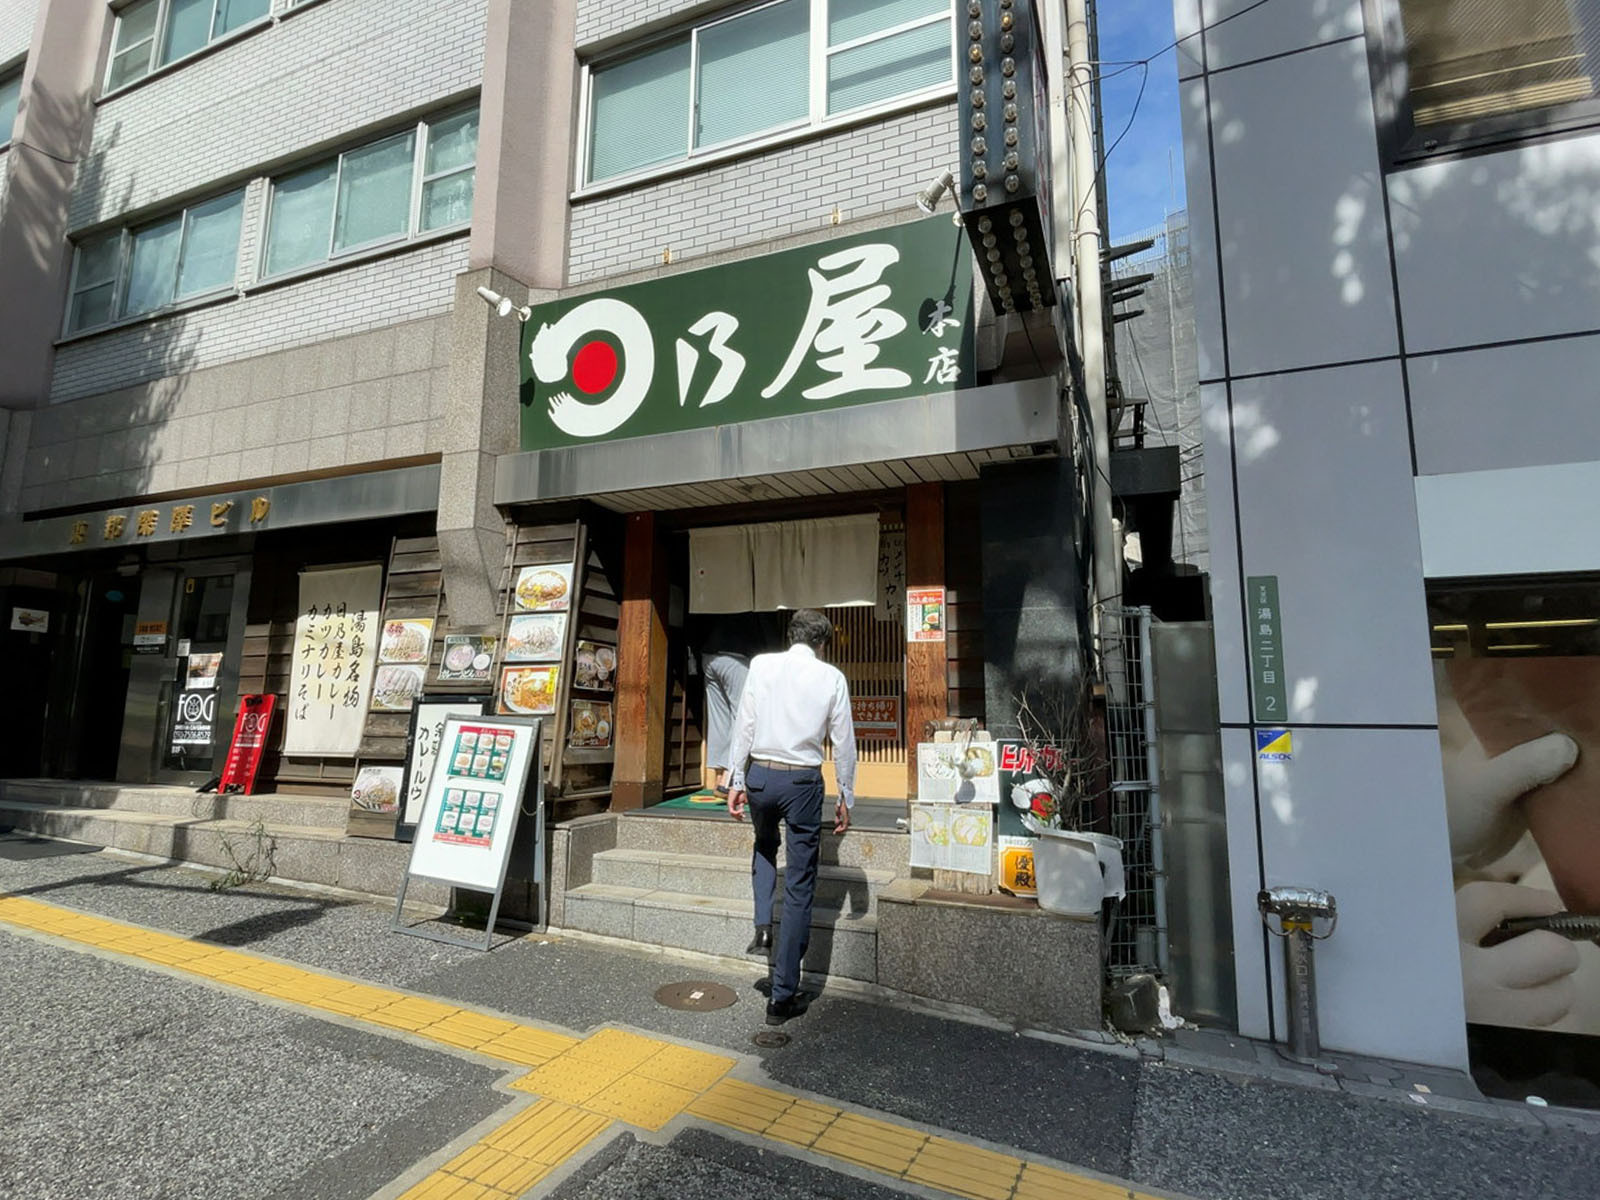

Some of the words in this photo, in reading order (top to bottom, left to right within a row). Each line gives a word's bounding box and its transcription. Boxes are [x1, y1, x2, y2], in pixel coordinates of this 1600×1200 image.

[295, 604, 318, 720] カミナリそば
[316, 603, 333, 699] カツカレー
[328, 602, 347, 720] 日乃屋カレー
[342, 609, 368, 708] 湯島名物
[1257, 607, 1276, 684] 湯島二丁目
[177, 693, 216, 722] FOG
[240, 713, 268, 733] FOG
[1265, 696, 1277, 712] 2
[410, 726, 430, 801] カレールウ
[1259, 753, 1292, 761] ALSOK
[1015, 855, 1036, 871] 優
[1015, 872, 1037, 888] 殿
